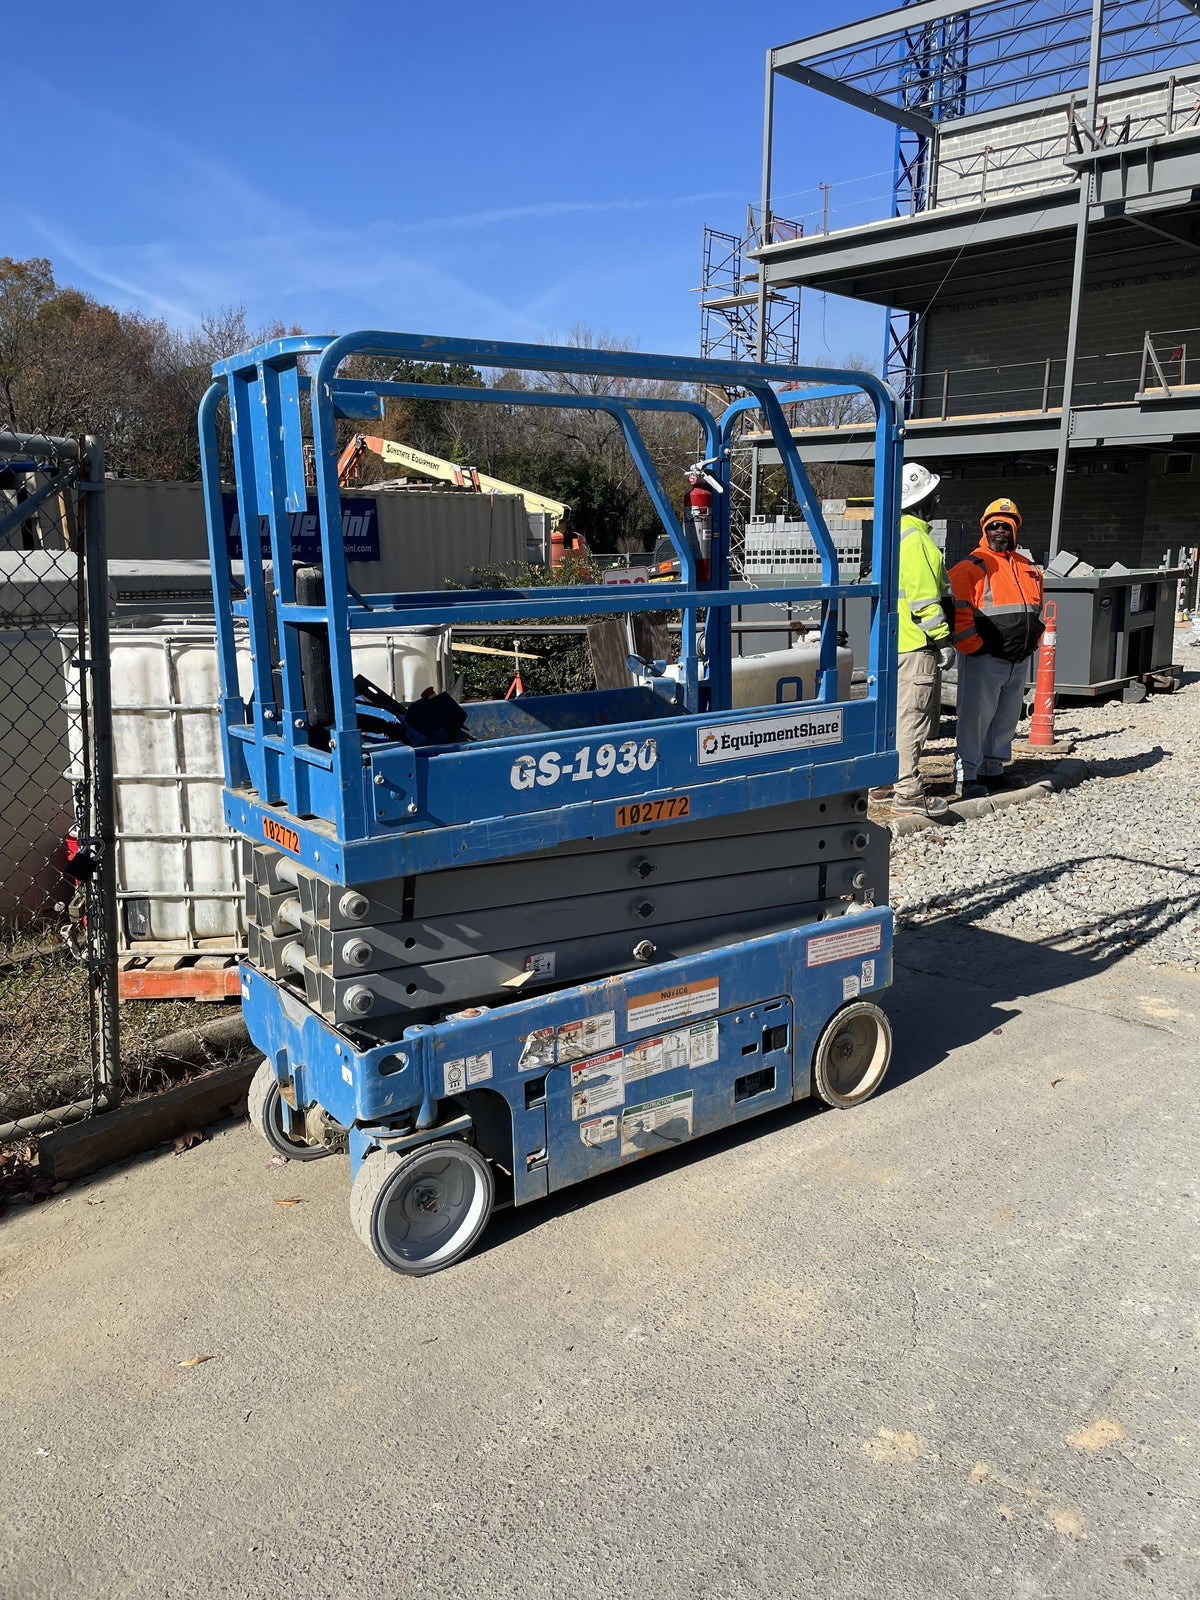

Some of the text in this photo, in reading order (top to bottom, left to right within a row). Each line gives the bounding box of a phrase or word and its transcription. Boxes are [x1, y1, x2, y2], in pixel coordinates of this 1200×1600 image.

[720, 720, 839, 751] EquipmentShare
[510, 738, 657, 790] GS-1930
[616, 796, 690, 826] 102772
[263, 817, 300, 854] 102772
[589, 1055, 611, 1067] DANGER
